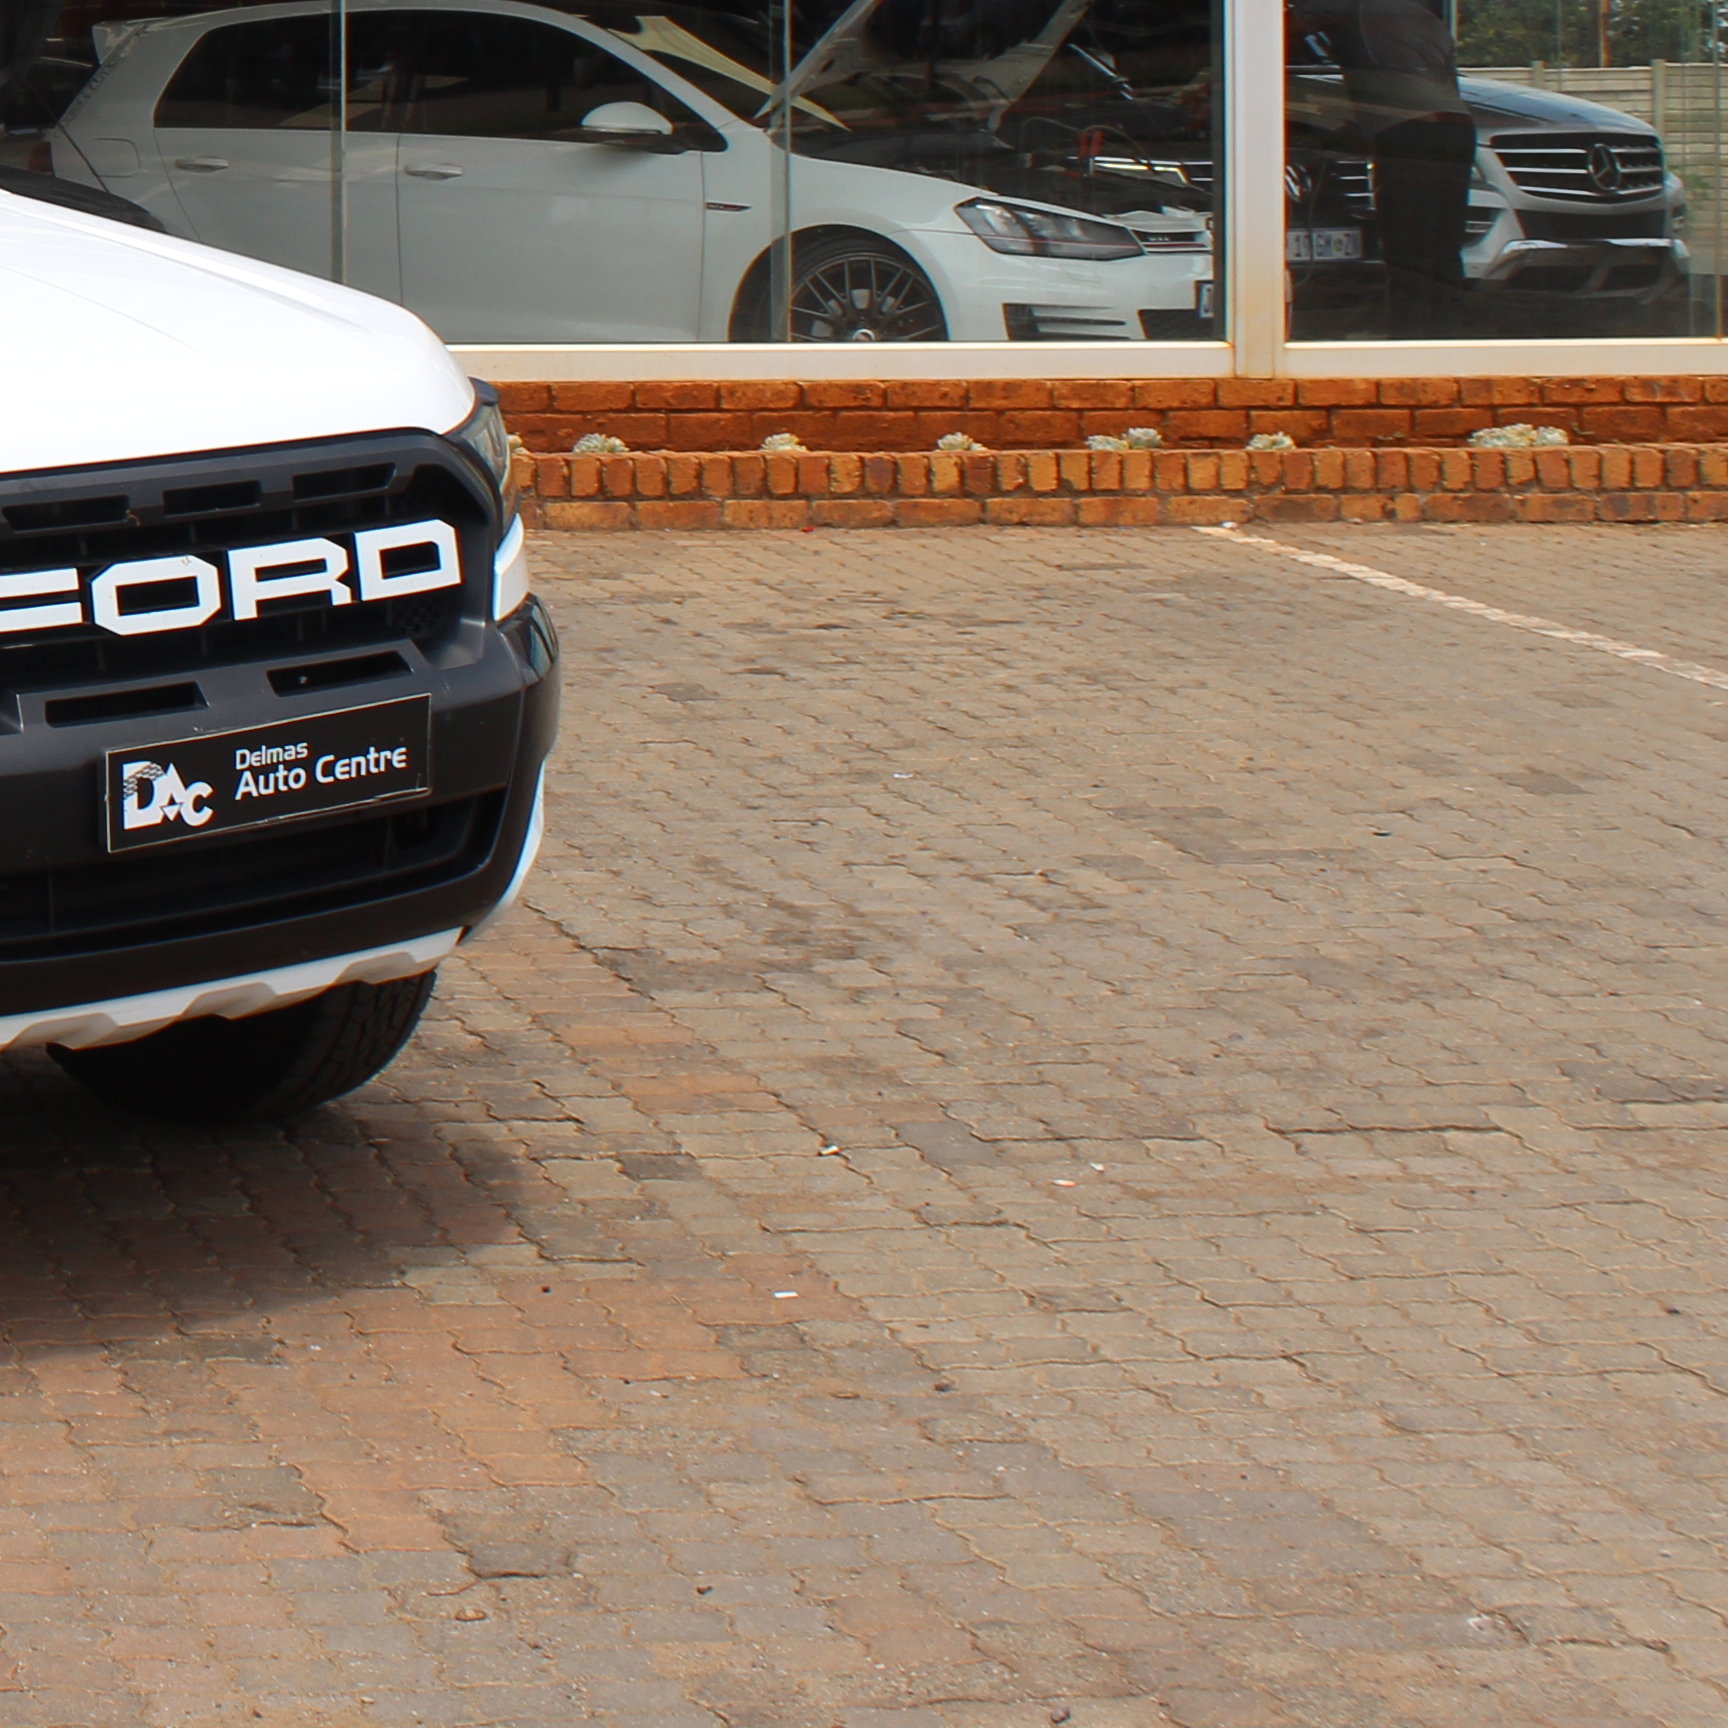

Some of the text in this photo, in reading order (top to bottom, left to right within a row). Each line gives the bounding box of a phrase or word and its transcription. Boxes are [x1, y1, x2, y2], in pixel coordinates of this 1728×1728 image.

[234, 741, 309, 770] Delmas
[234, 746, 408, 801] Auto Centre
[122, 760, 215, 828] DAC
